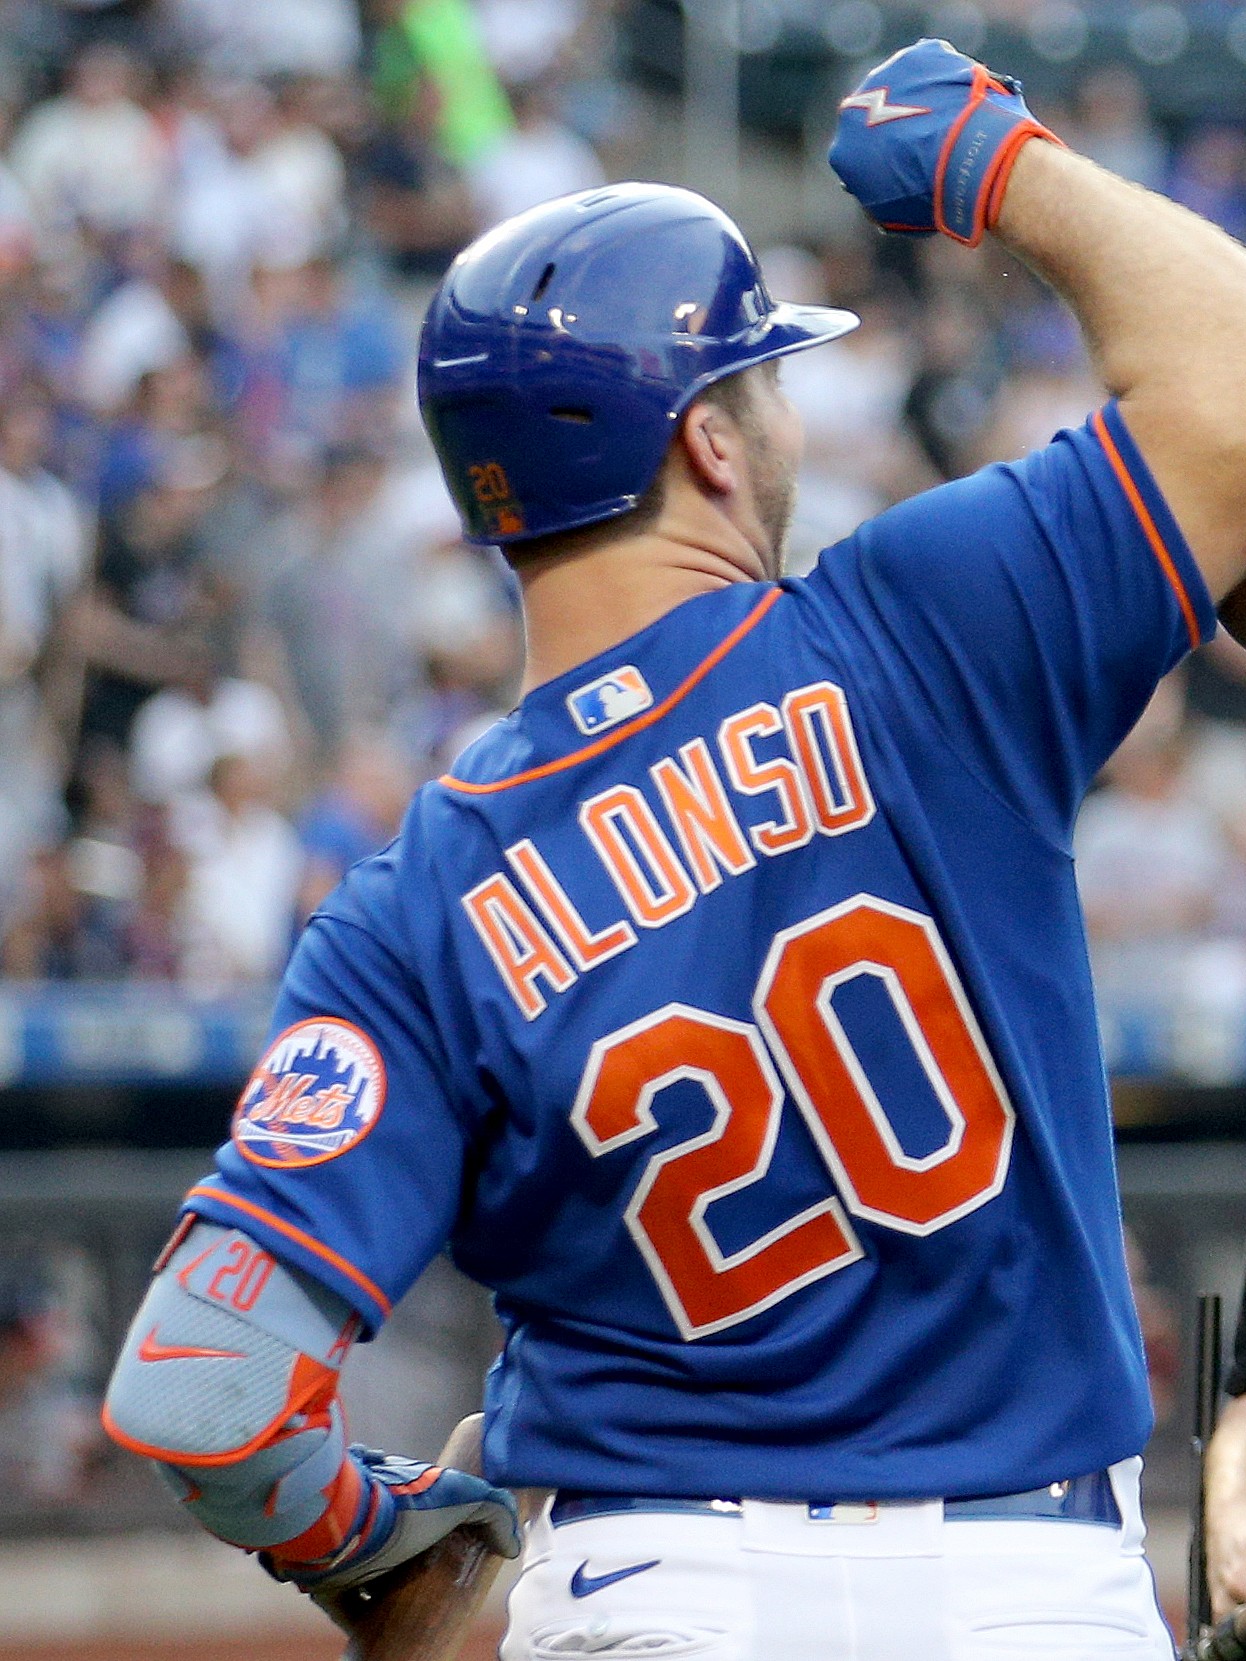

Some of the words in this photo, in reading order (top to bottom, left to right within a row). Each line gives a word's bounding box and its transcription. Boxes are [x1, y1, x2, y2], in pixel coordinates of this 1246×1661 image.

[468, 463, 508, 502] 20
[461, 681, 876, 1022] ALONSO
[248, 1073, 356, 1129] Mets
[569, 892, 1015, 1342] 20
[207, 1240, 277, 1312] 20
